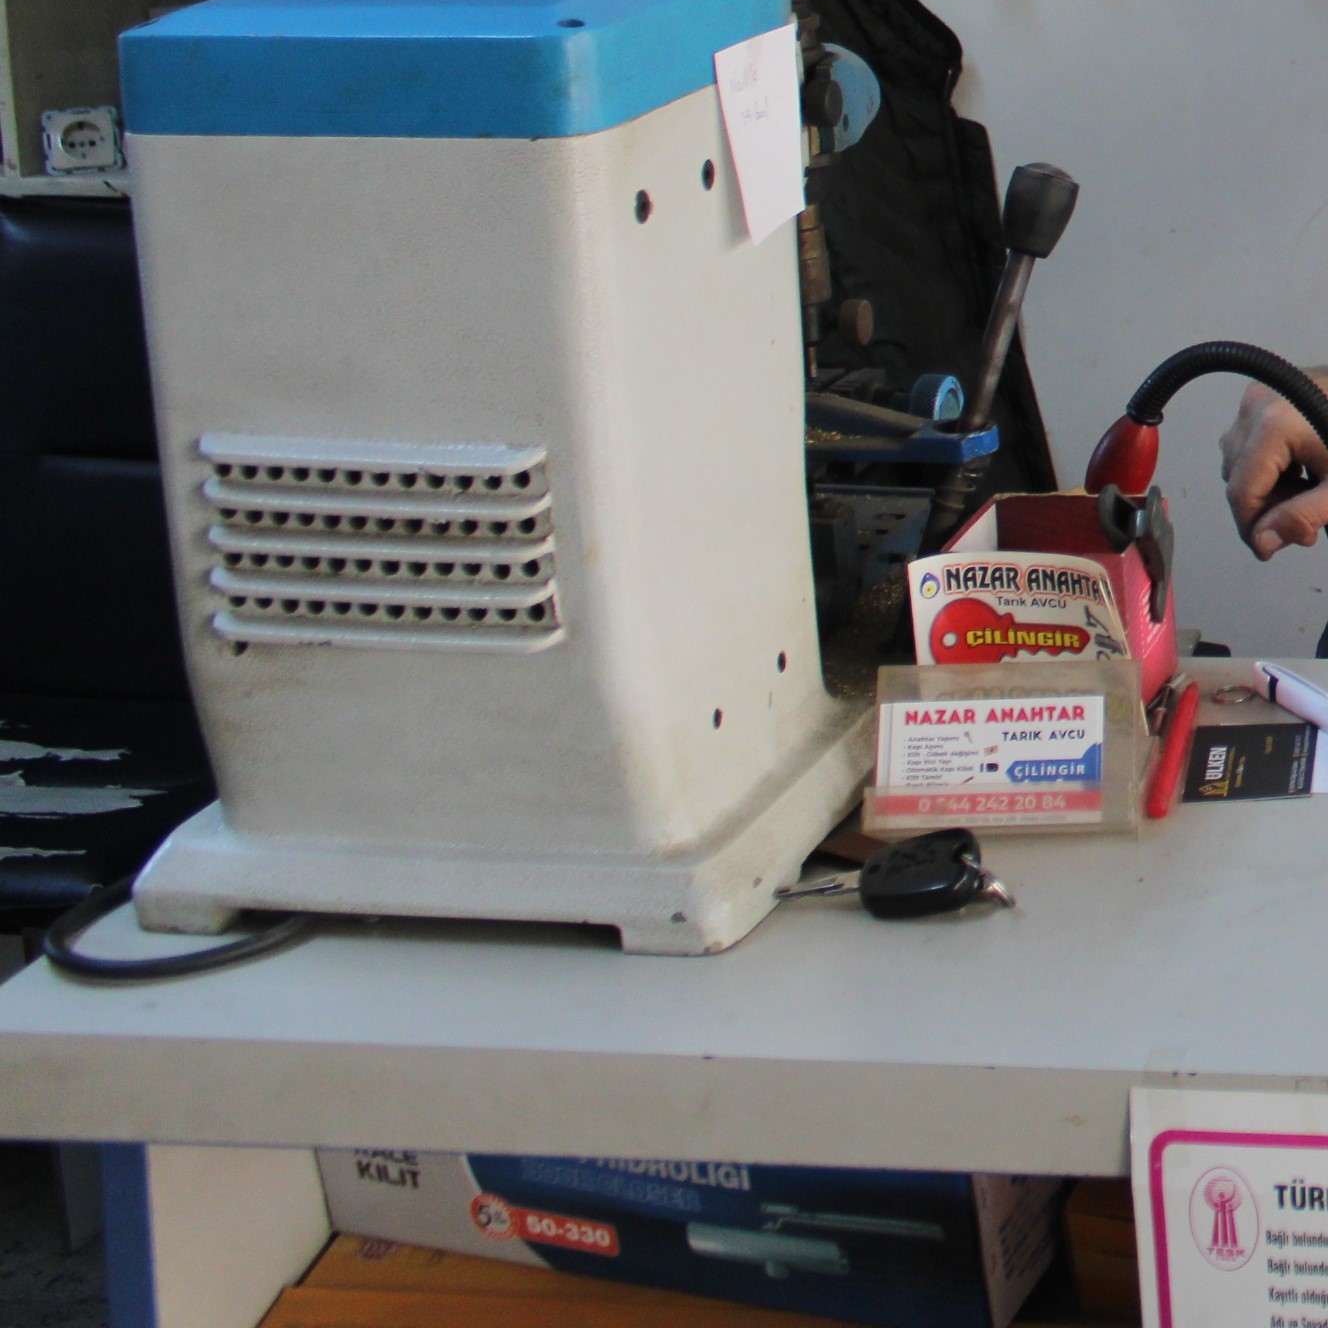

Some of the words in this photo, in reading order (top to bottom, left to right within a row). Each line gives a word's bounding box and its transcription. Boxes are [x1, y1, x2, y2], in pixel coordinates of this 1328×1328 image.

[945, 566, 1020, 592] NAZAR
[1031, 599, 1066, 610] AVCU
[966, 628, 1080, 648] ÇİLİNGİR
[905, 709, 976, 726] NAZAR
[985, 706, 1085, 723] ANAHTAR
[1002, 730, 1042, 742] TARIK
[1049, 729, 1085, 740] AVCU
[1014, 762, 1086, 779] ÇİLİNGİR
[975, 797, 1008, 812] 242
[1014, 795, 1037, 810] 20
[1041, 794, 1066, 809] 84
[1266, 1229, 1289, 1249] Bağlı
[1267, 1258, 1290, 1278] Bağlı
[1268, 1287, 1298, 1306] Kayıtlı
